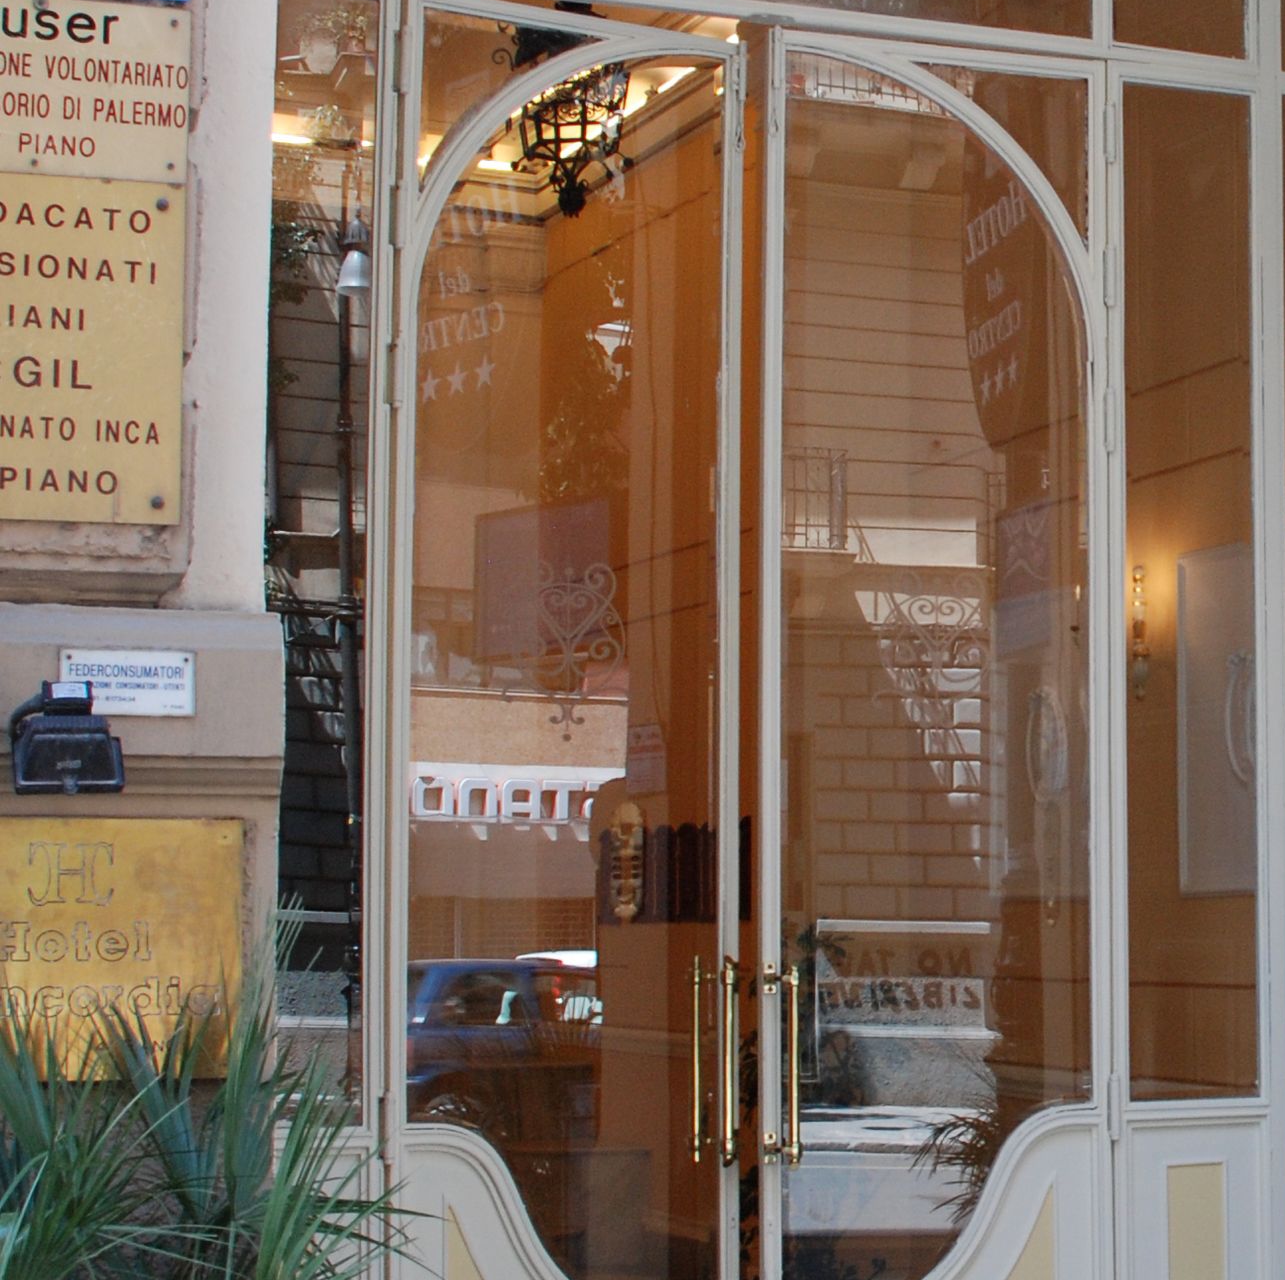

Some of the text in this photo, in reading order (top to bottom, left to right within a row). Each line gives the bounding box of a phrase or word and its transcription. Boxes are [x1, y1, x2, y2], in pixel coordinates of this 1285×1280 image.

[45, 55, 188, 90] VOLONTARIATO
[3, 92, 187, 129] ORIO DI PALERMO
[18, 132, 96, 158] PIANO
[0, 252, 156, 285] SIONATI
[96, 418, 160, 445] INCA
[0, 466, 118, 495] PIANO
[69, 663, 185, 680] FEDERCONSUMATORI
